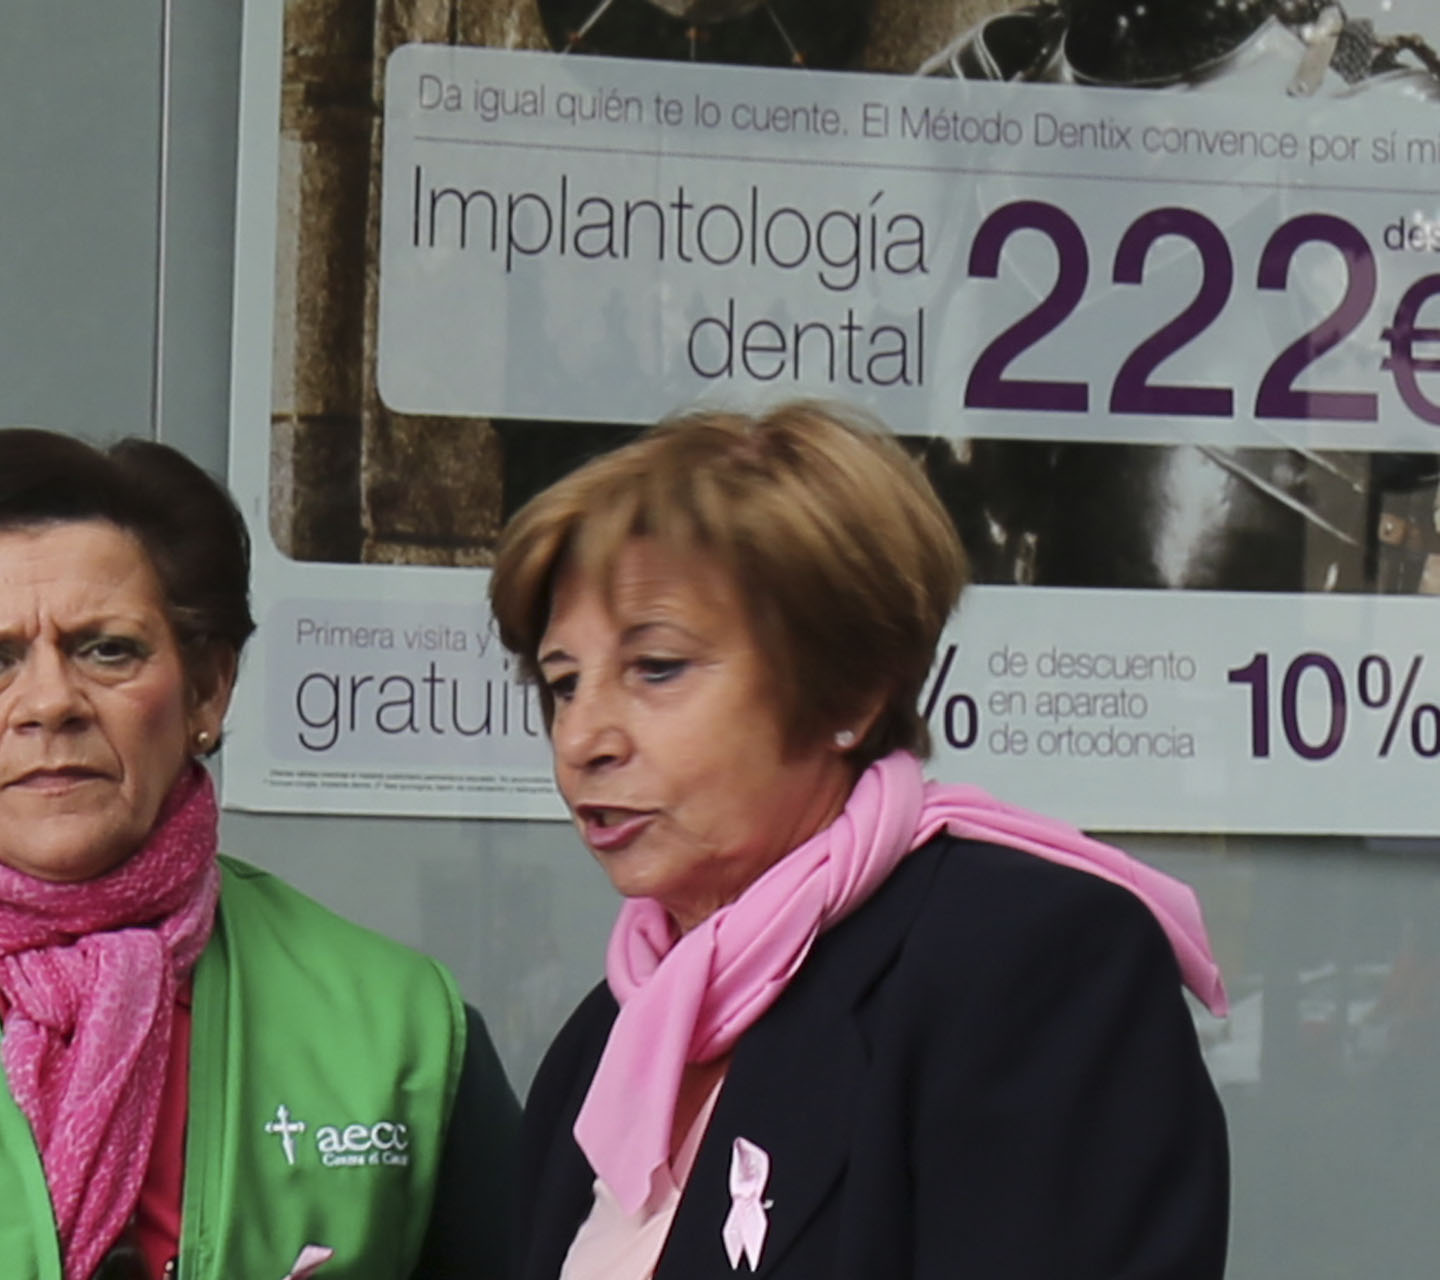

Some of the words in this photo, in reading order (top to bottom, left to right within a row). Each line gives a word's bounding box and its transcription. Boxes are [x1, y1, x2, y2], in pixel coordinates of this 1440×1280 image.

[418, 74, 463, 111] Da
[474, 80, 545, 122] igual
[556, 86, 643, 127] quién
[654, 94, 683, 125] te
[694, 94, 721, 129] lo
[732, 102, 849, 136] cuente.
[862, 104, 889, 139] El
[901, 107, 1022, 146] Método
[1034, 113, 1132, 151] Dentix
[1143, 124, 1298, 158] convence
[1309, 135, 1361, 167] por
[1372, 128, 1397, 163] sí
[413, 165, 929, 292] Implantología
[687, 298, 925, 387] dental
[296, 618, 394, 649] Primera
[403, 626, 468, 651] visita
[476, 633, 491, 656] y
[988, 647, 1027, 678] de
[1036, 647, 1196, 681] descuento
[988, 691, 1026, 716] en
[1036, 690, 1148, 724] aparato
[1227, 652, 1440, 762] 10%
[988, 727, 1027, 756] de
[1036, 727, 1195, 759] ortodoncia
